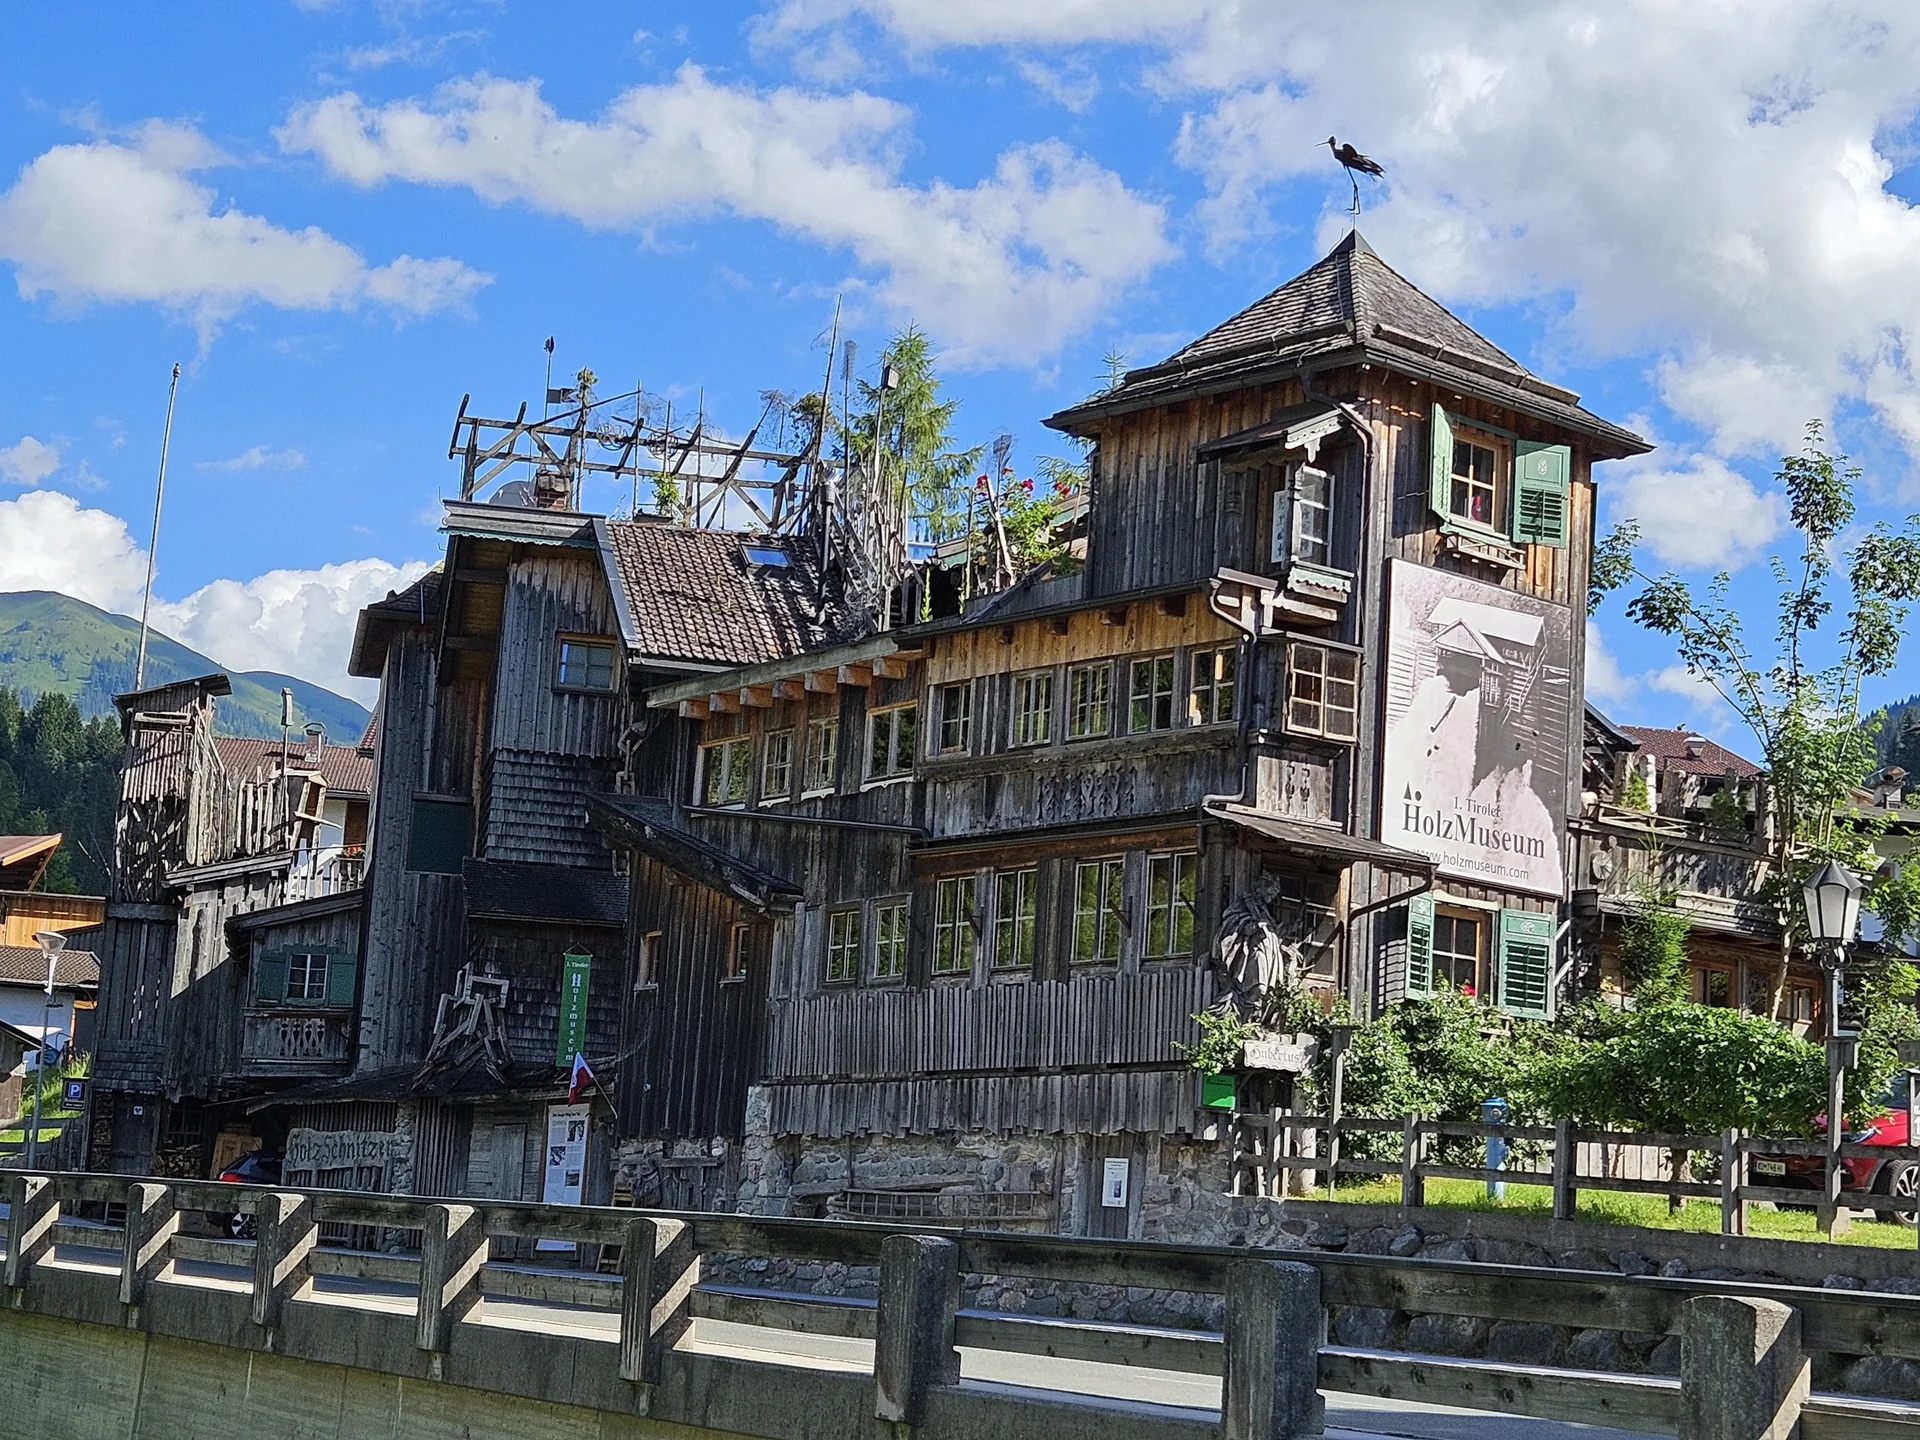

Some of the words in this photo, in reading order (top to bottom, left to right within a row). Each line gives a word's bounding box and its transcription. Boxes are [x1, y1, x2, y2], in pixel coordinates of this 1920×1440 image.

[1454, 797, 1462, 810] 1.
[1465, 798, 1501, 818] Tiroler
[1402, 803, 1545, 859] HolzMuseum
[1250, 1045, 1300, 1063] Hubertus
[71, 1085, 80, 1096] P
